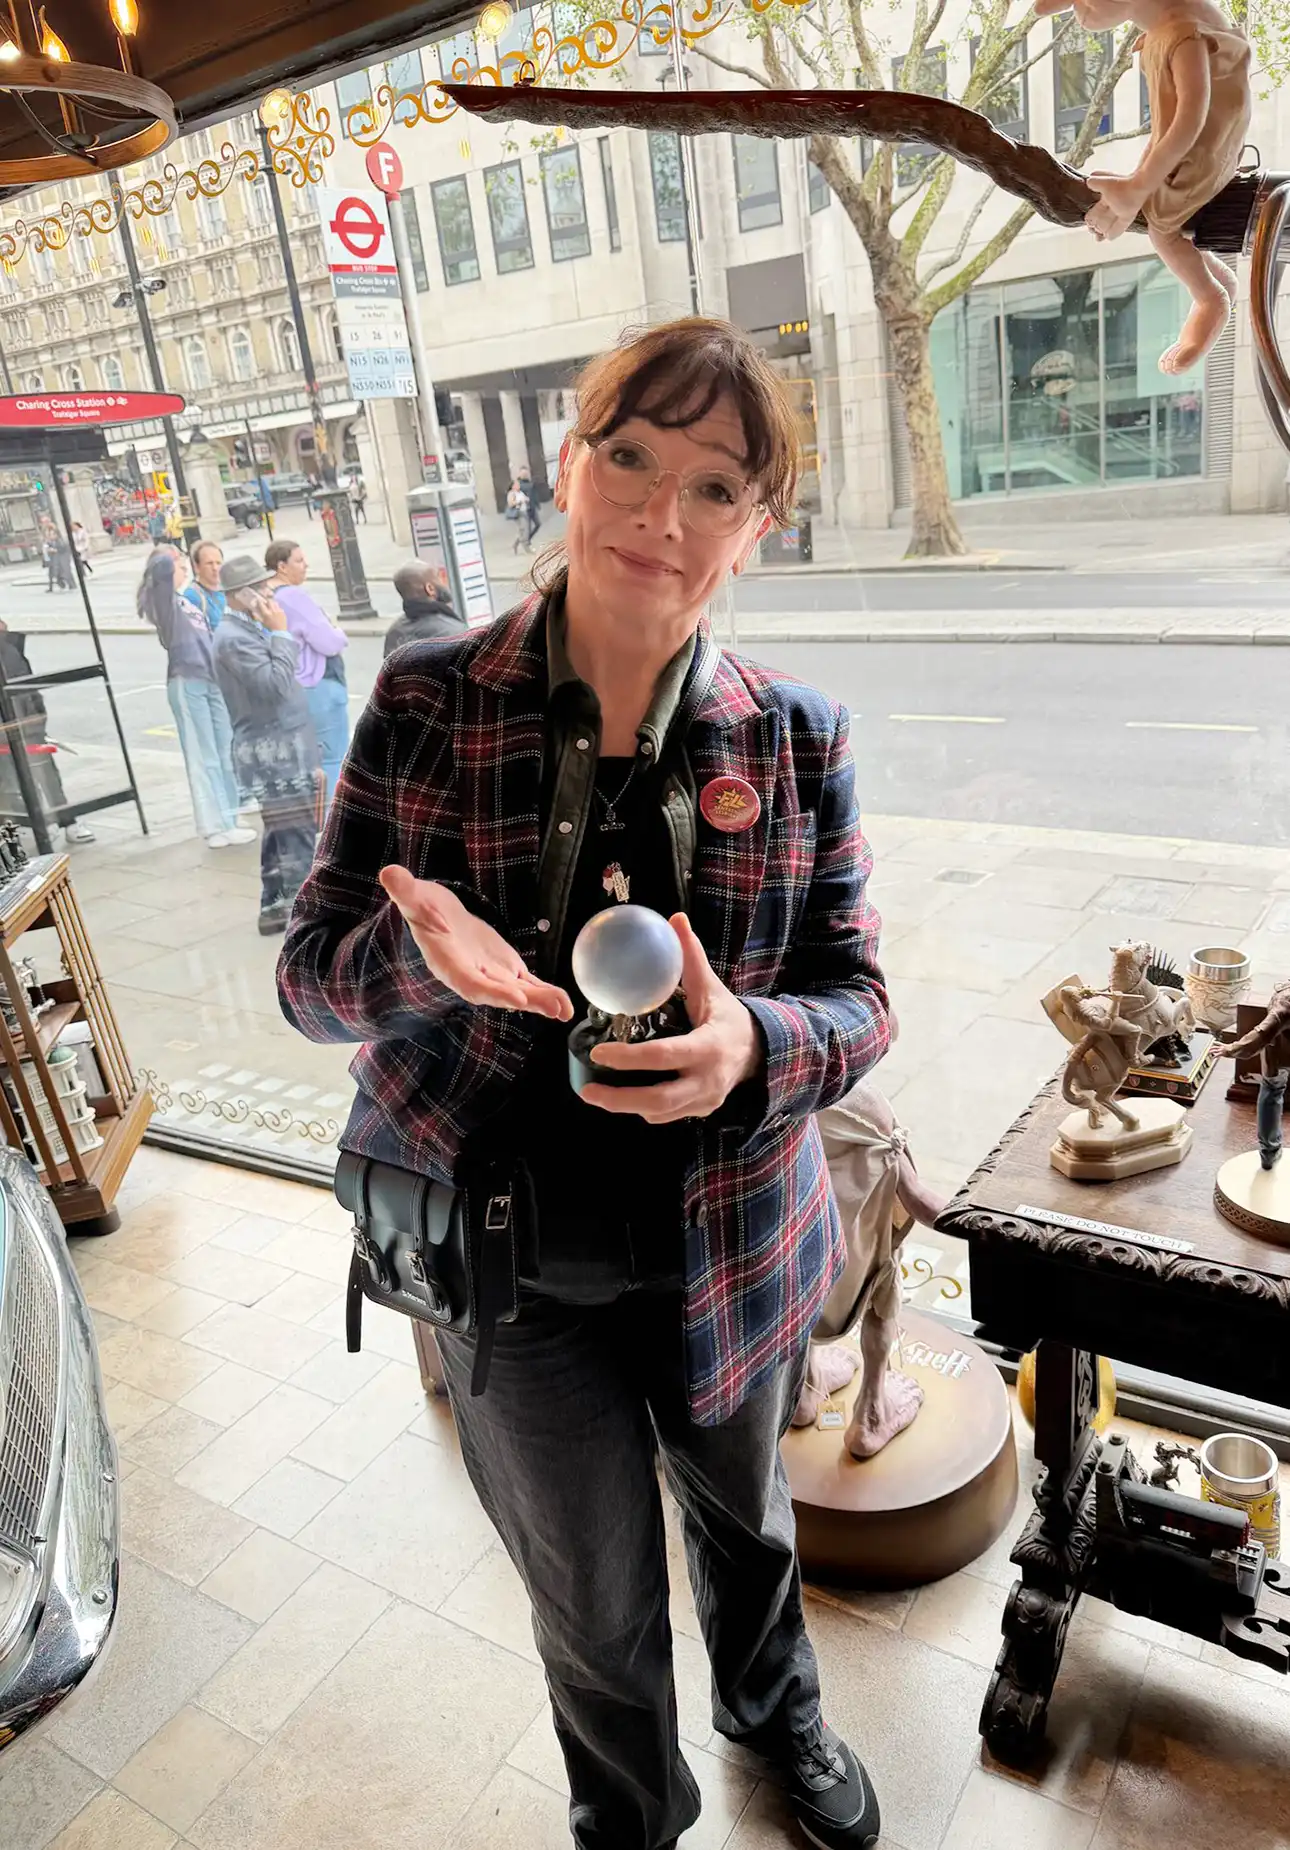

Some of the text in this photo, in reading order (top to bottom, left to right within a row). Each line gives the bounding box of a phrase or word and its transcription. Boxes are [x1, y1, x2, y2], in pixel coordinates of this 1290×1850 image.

[378, 151, 394, 185] F
[350, 355, 367, 367] N15
[16, 397, 106, 411] Charing Cross Station
[79, 409, 101, 418] Square
[1023, 1207, 1183, 1249] PLEASE DO NOT TOUCH
